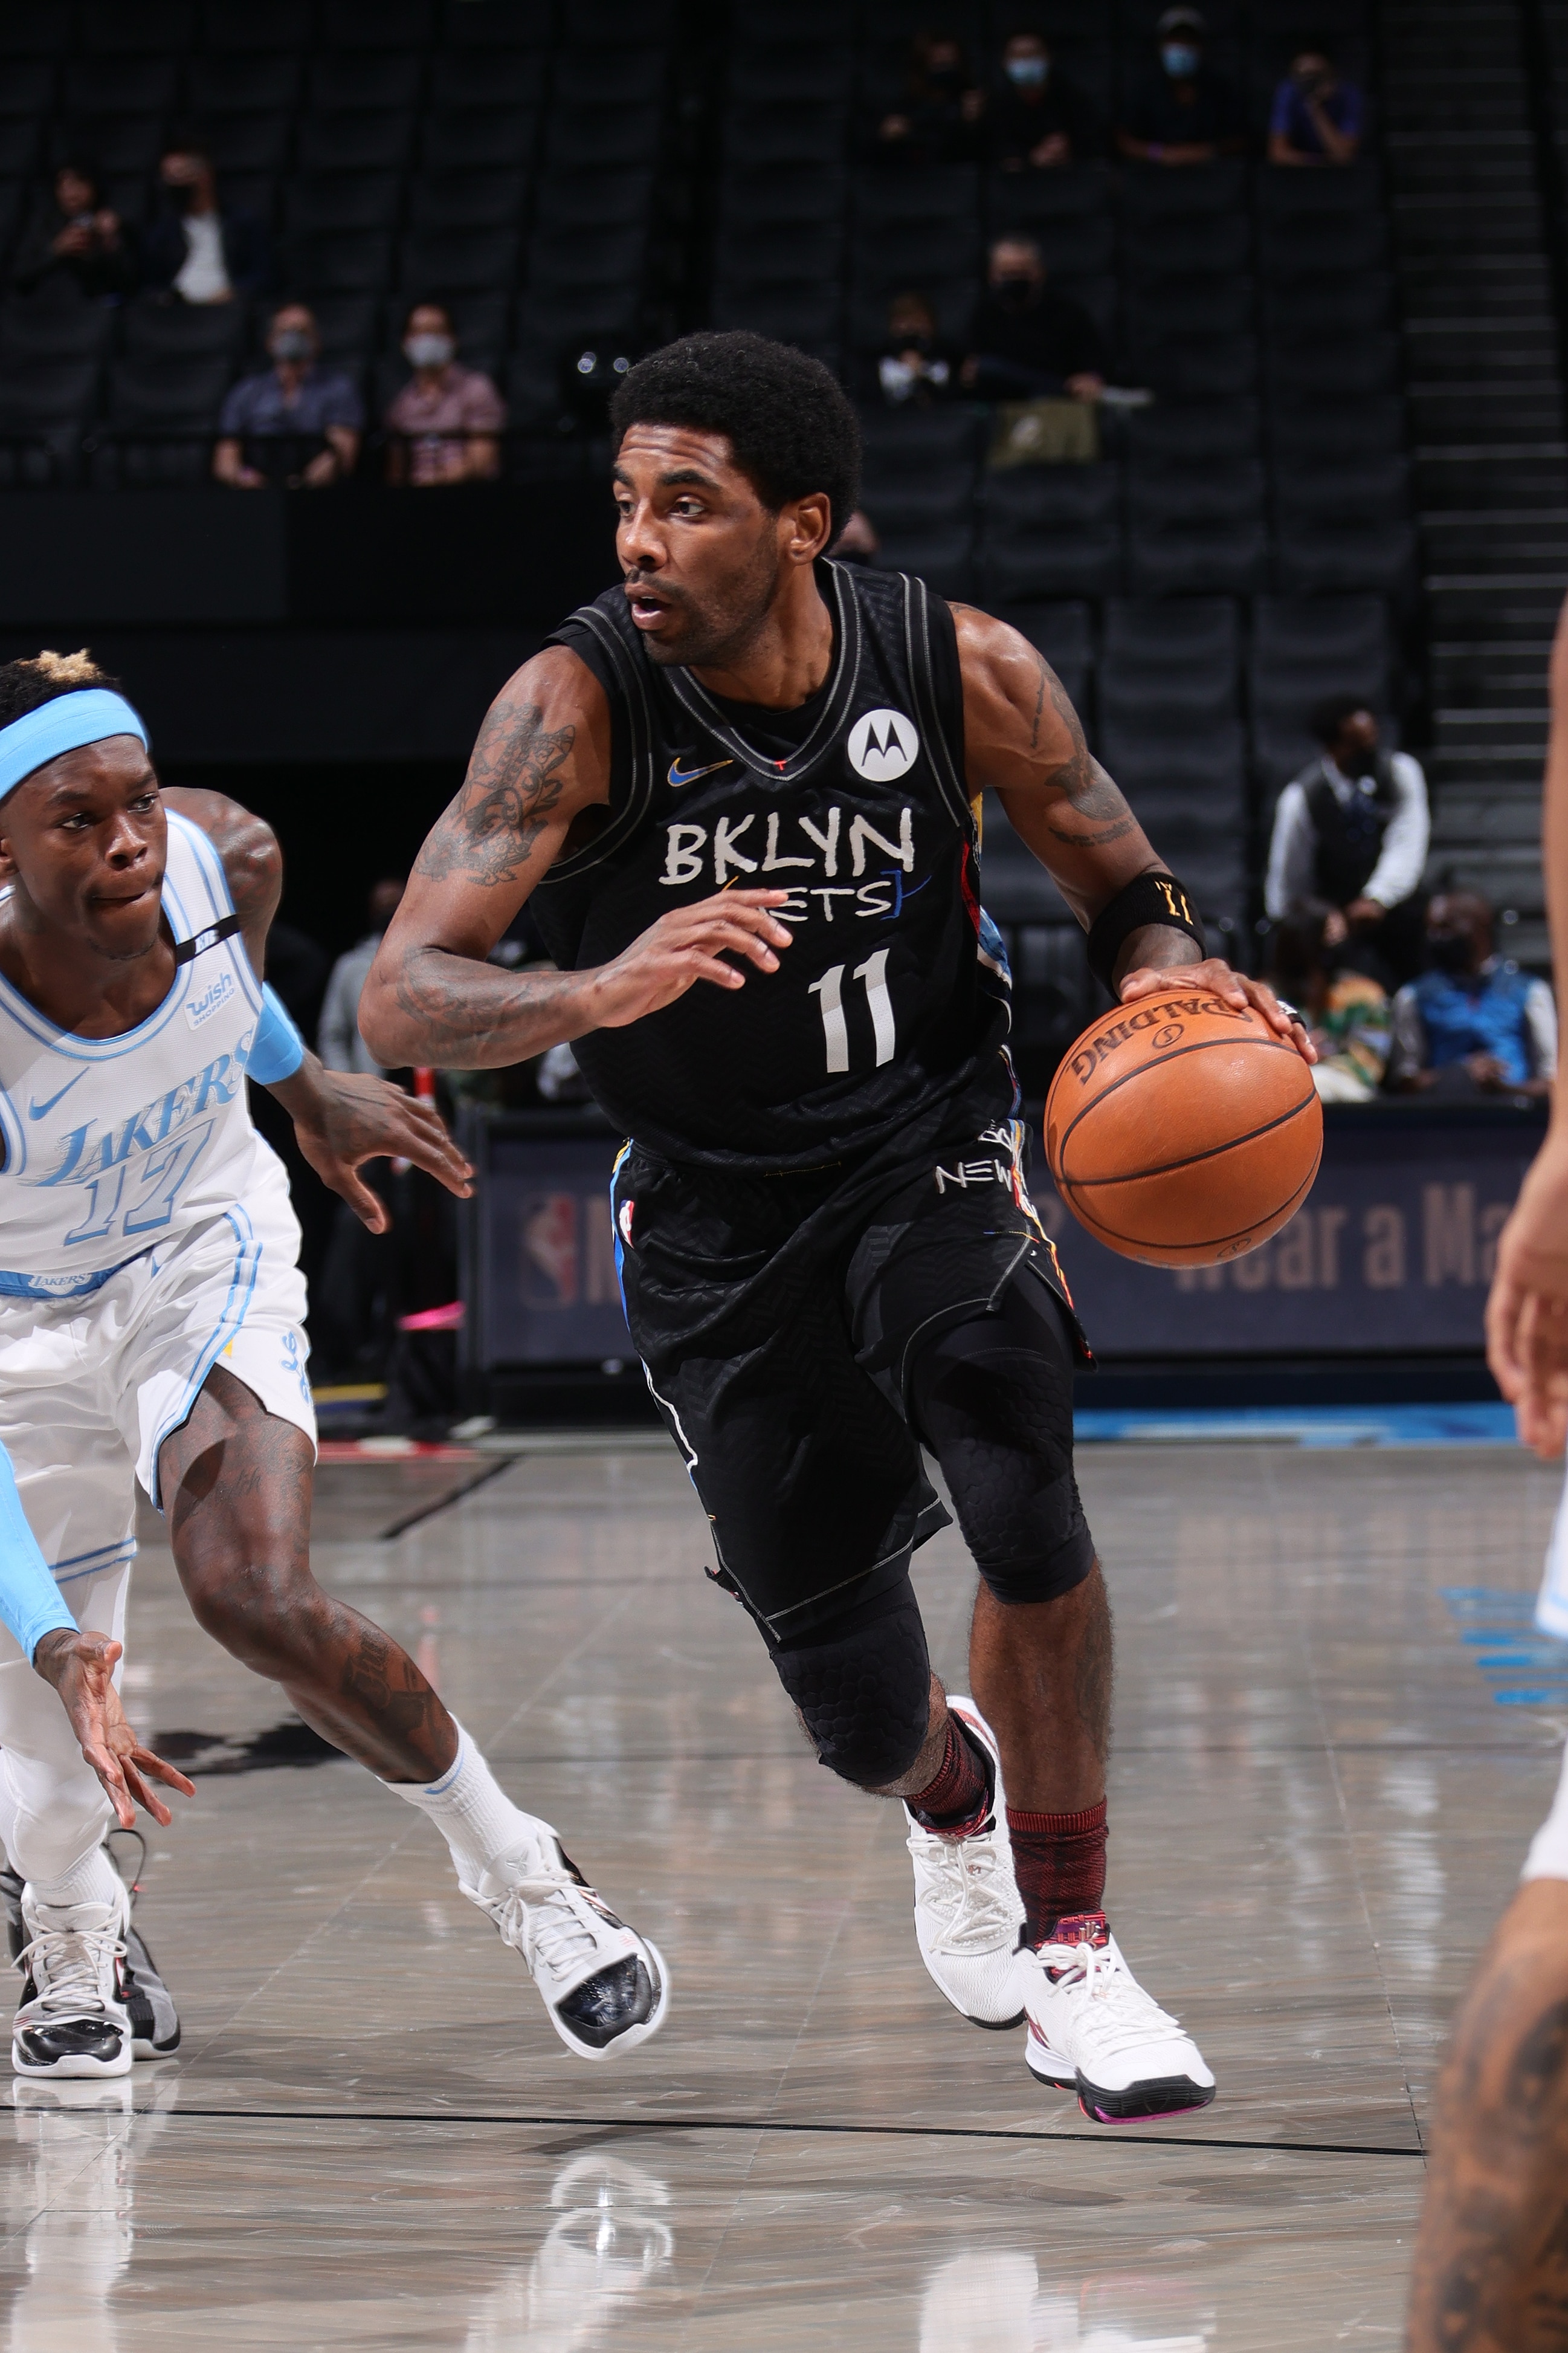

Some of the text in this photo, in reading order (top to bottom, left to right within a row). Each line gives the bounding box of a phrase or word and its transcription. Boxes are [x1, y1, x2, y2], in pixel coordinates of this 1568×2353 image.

[659, 807, 915, 885] BKLYN
[758, 880, 892, 922] ETS
[186, 973, 232, 1017] wish
[193, 988, 235, 1026] SHOPPING
[807, 948, 896, 1073] 11
[1068, 997, 1253, 1086] PALDING
[22, 1029, 255, 1187] LAKERS
[63, 1117, 217, 1247] 17
[935, 1159, 1013, 1194] NEW
[28, 1274, 92, 1288] LAKERS
[1361, 1203, 1406, 1289] a
